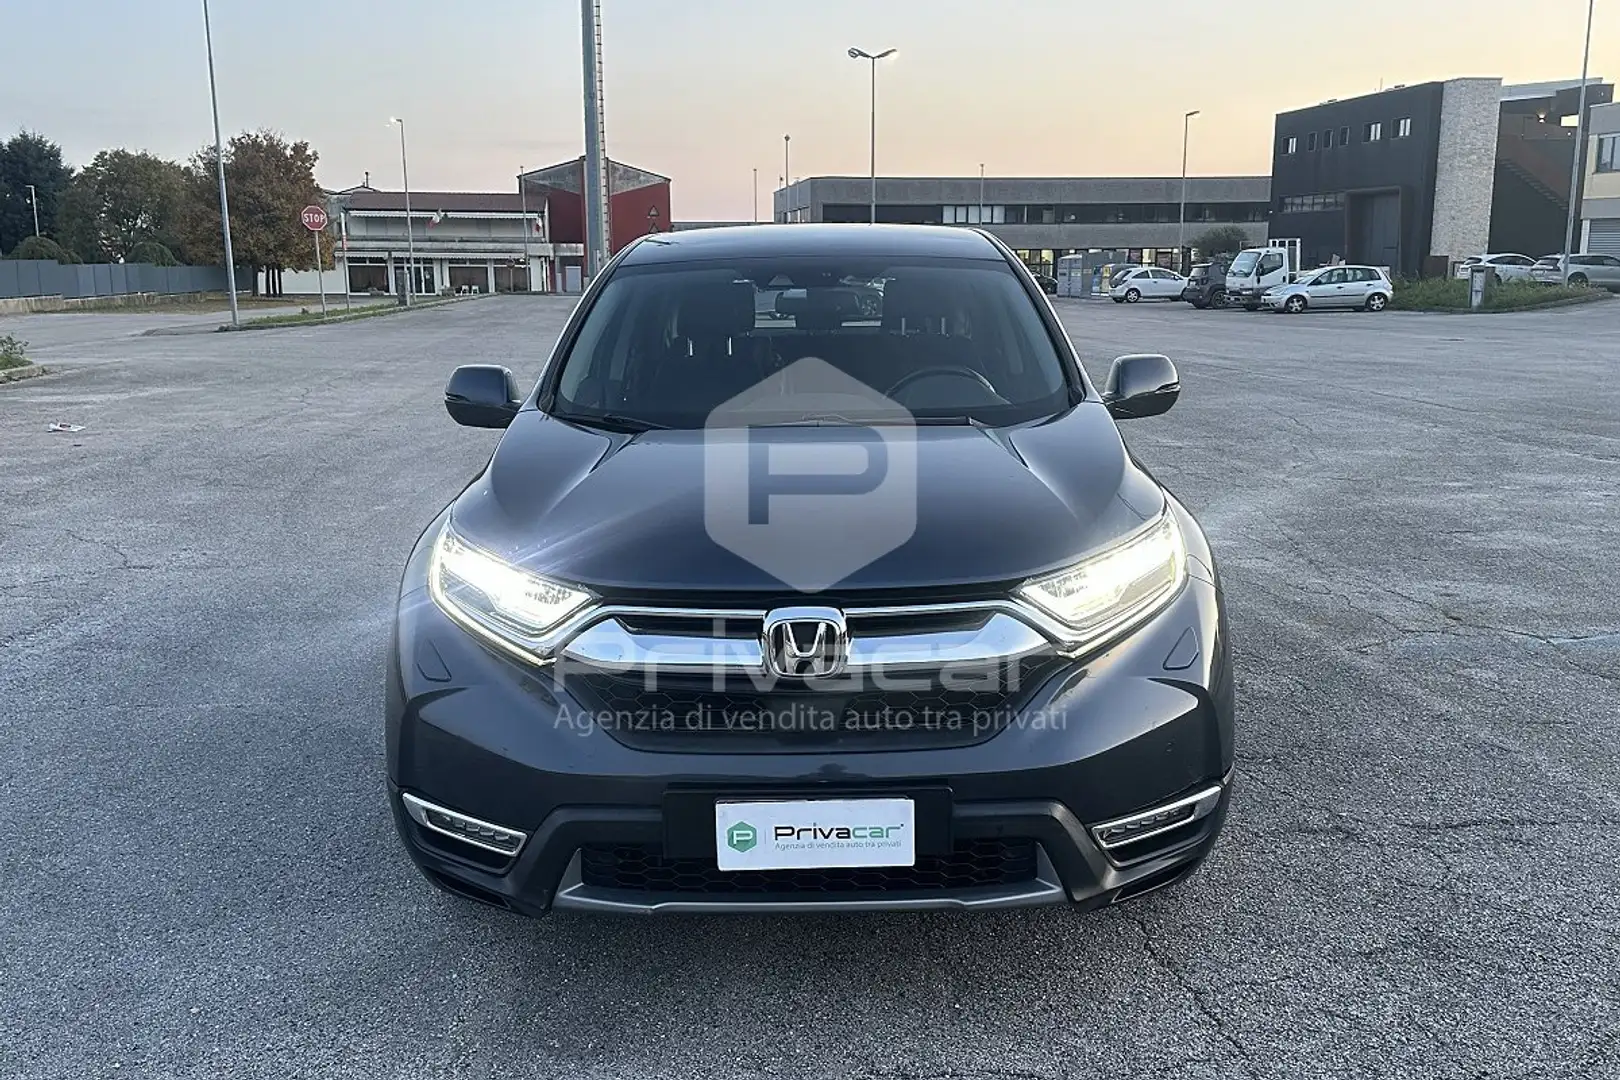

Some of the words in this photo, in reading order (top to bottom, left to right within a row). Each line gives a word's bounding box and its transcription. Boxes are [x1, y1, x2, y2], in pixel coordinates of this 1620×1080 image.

[303, 213, 326, 223] STOP
[733, 830, 754, 845] P
[774, 822, 902, 841] Privacar
[775, 842, 806, 851] Agenzia
[807, 841, 815, 849] di
[816, 841, 845, 849] vendita
[865, 840, 876, 848] tra
[877, 839, 902, 849] privati
